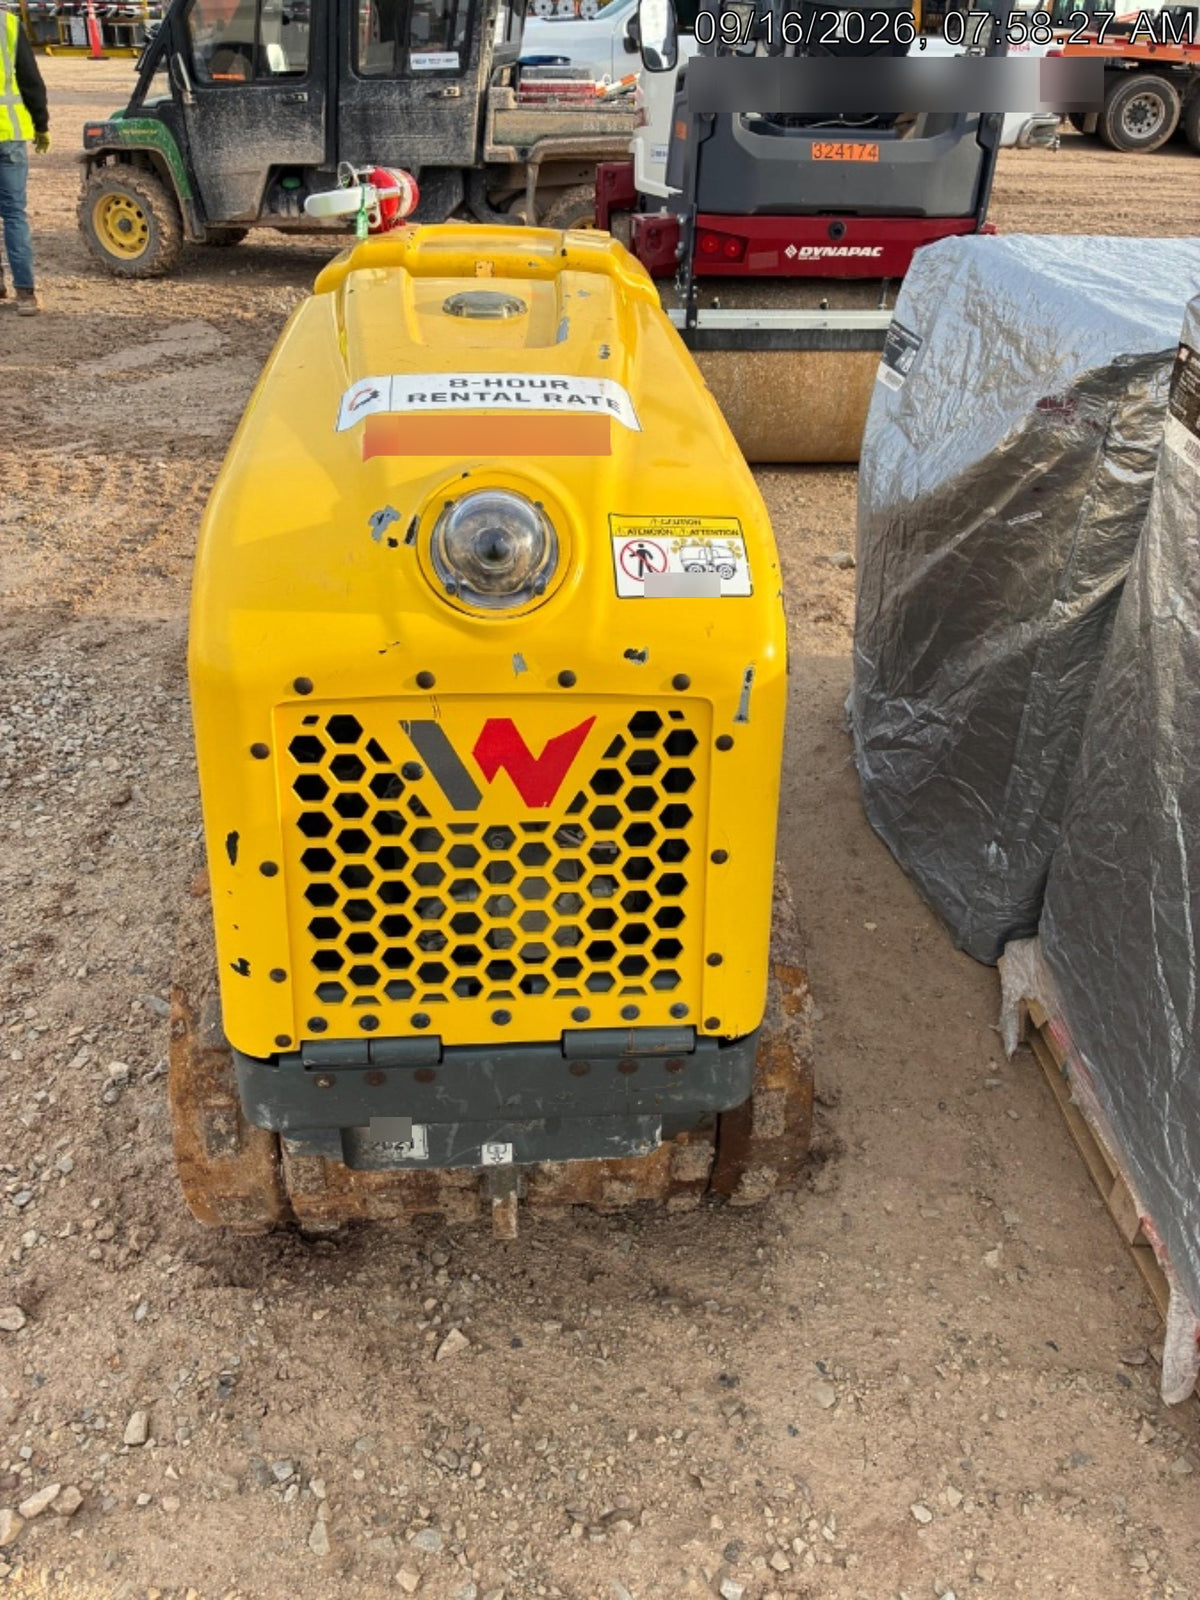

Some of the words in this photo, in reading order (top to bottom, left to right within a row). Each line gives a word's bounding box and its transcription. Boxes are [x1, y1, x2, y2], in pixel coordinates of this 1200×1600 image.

[813, 143, 878, 160] 324174
[799, 246, 884, 257] DYNAPAC
[449, 378, 570, 390] 8-HOUR
[407, 392, 531, 403] RENTAL
[543, 392, 621, 414] RATE
